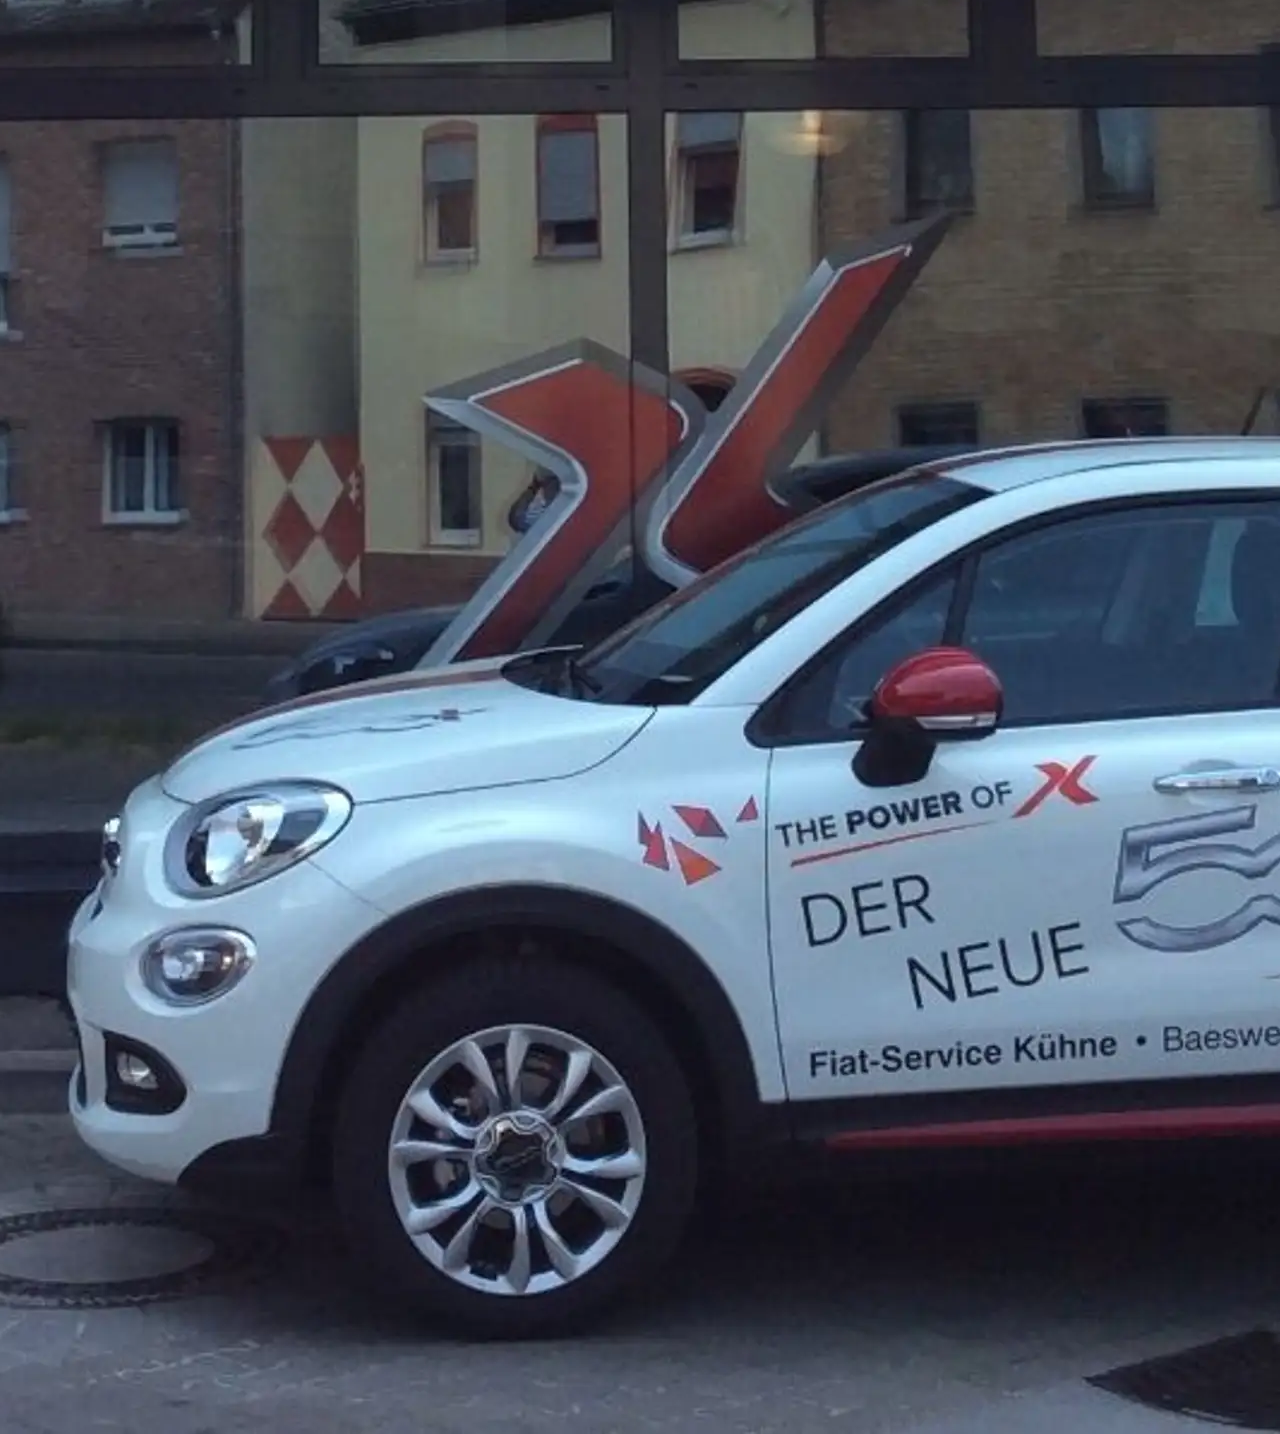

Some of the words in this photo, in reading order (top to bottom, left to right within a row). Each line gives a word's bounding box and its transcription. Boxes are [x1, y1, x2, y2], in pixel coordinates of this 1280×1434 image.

[774, 815, 840, 849] THE
[846, 789, 963, 836] POWER
[970, 780, 1013, 810] OF
[1011, 754, 1101, 819] X
[800, 873, 936, 948] DER
[906, 921, 1091, 1011] NEUE
[808, 1039, 1003, 1079] Fiat-Service
[1013, 1031, 1118, 1064] Kühne
